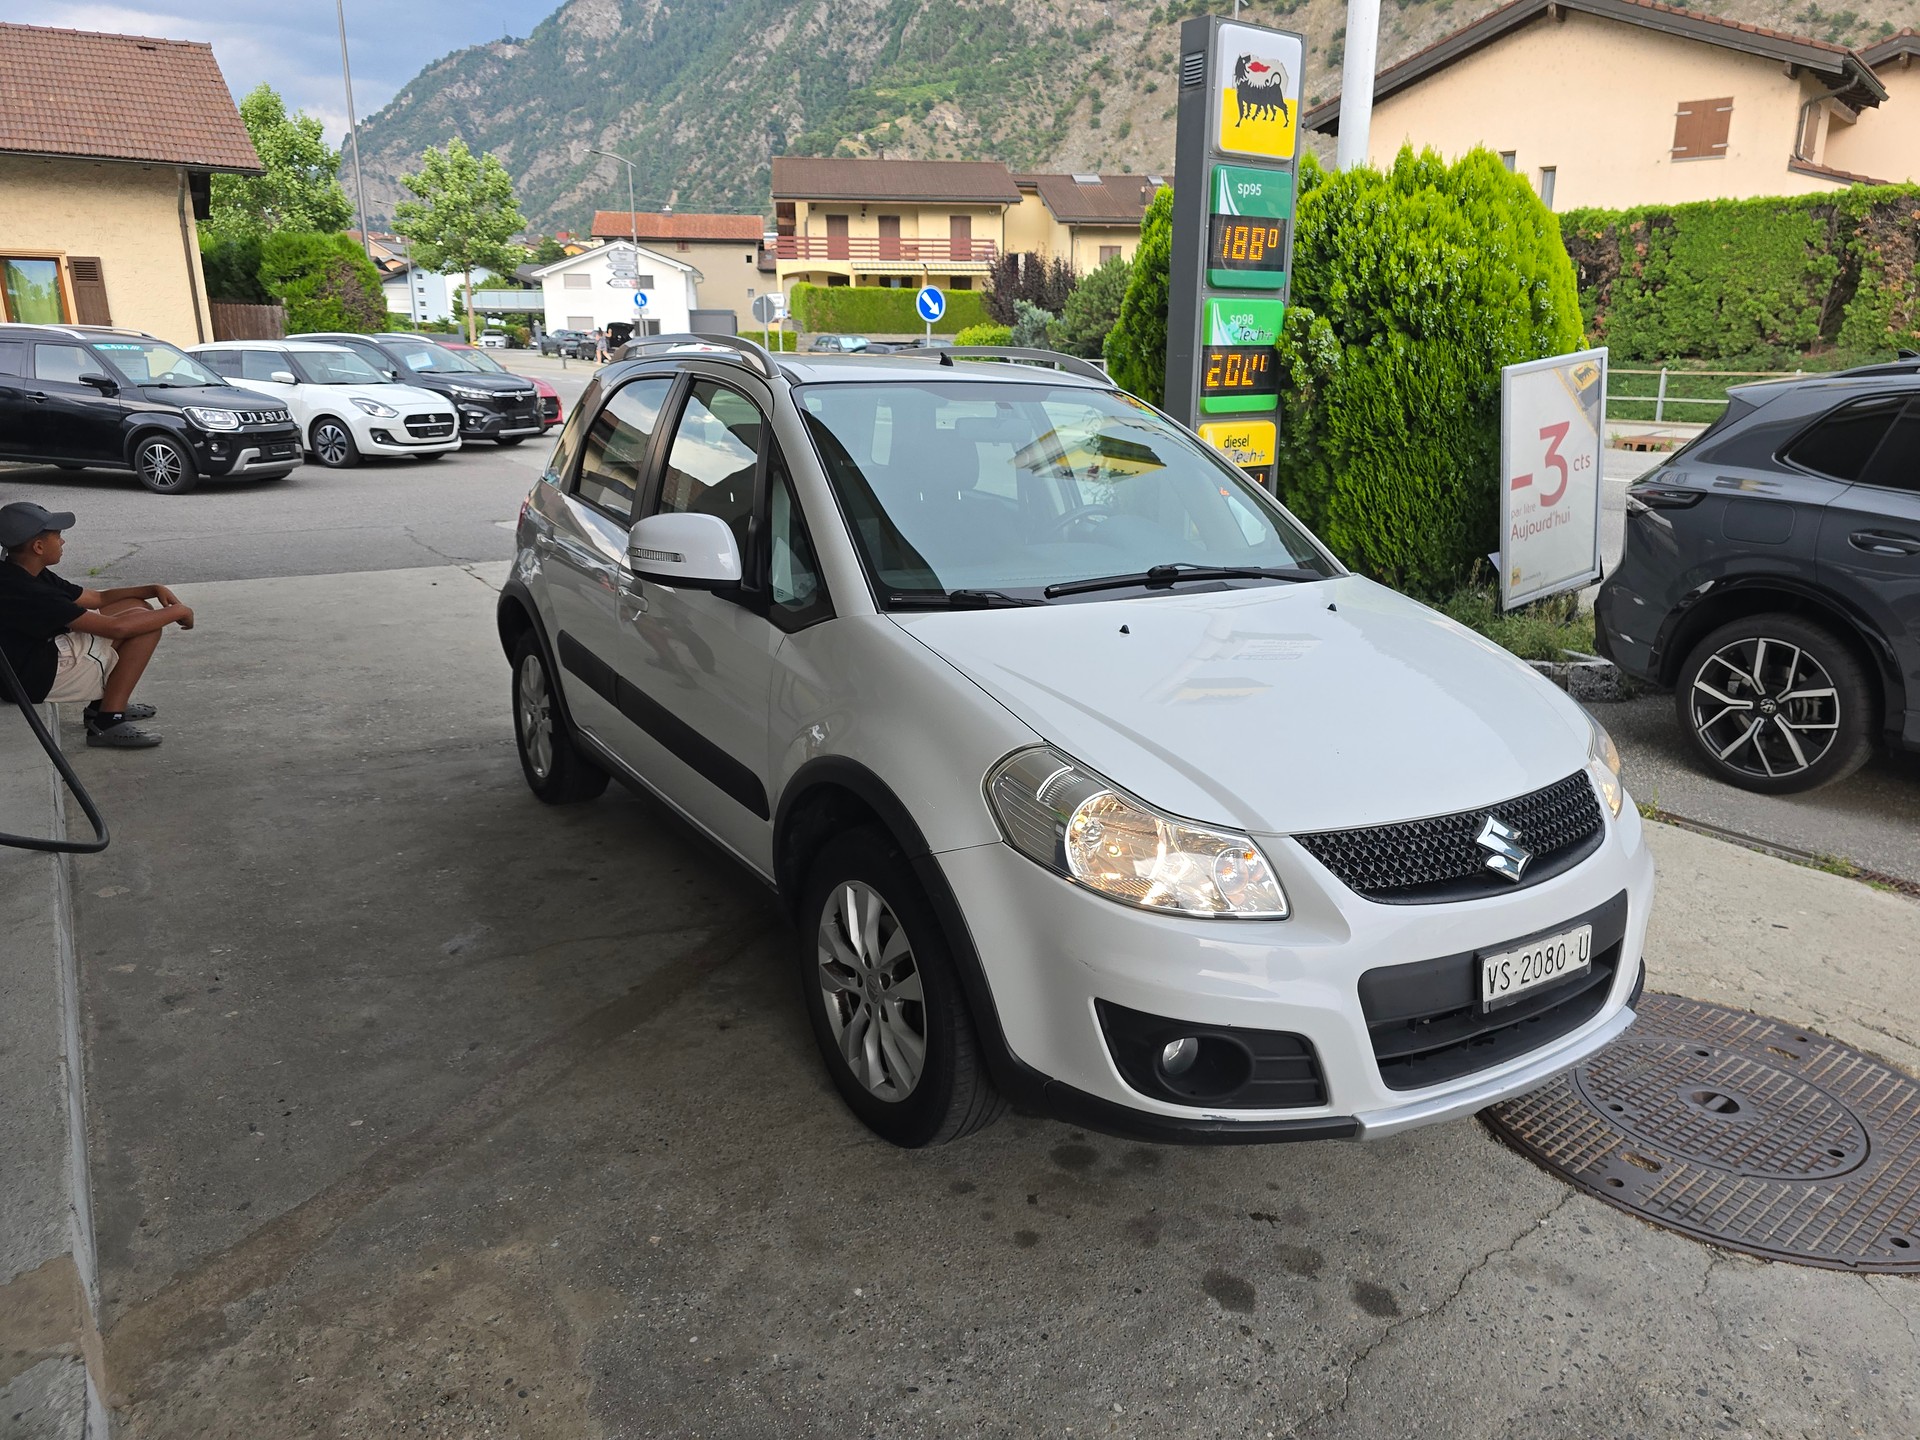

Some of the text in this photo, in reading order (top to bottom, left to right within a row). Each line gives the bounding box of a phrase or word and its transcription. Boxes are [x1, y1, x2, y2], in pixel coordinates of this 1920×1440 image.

[1237, 182, 1262, 198] sp95
[1230, 313, 1254, 326] sp98
[1223, 434, 1250, 449] diesel
[1573, 454, 1591, 472] cts
[1511, 503, 1536, 519] par litre
[1511, 505, 1571, 541] Aujourd'hui
